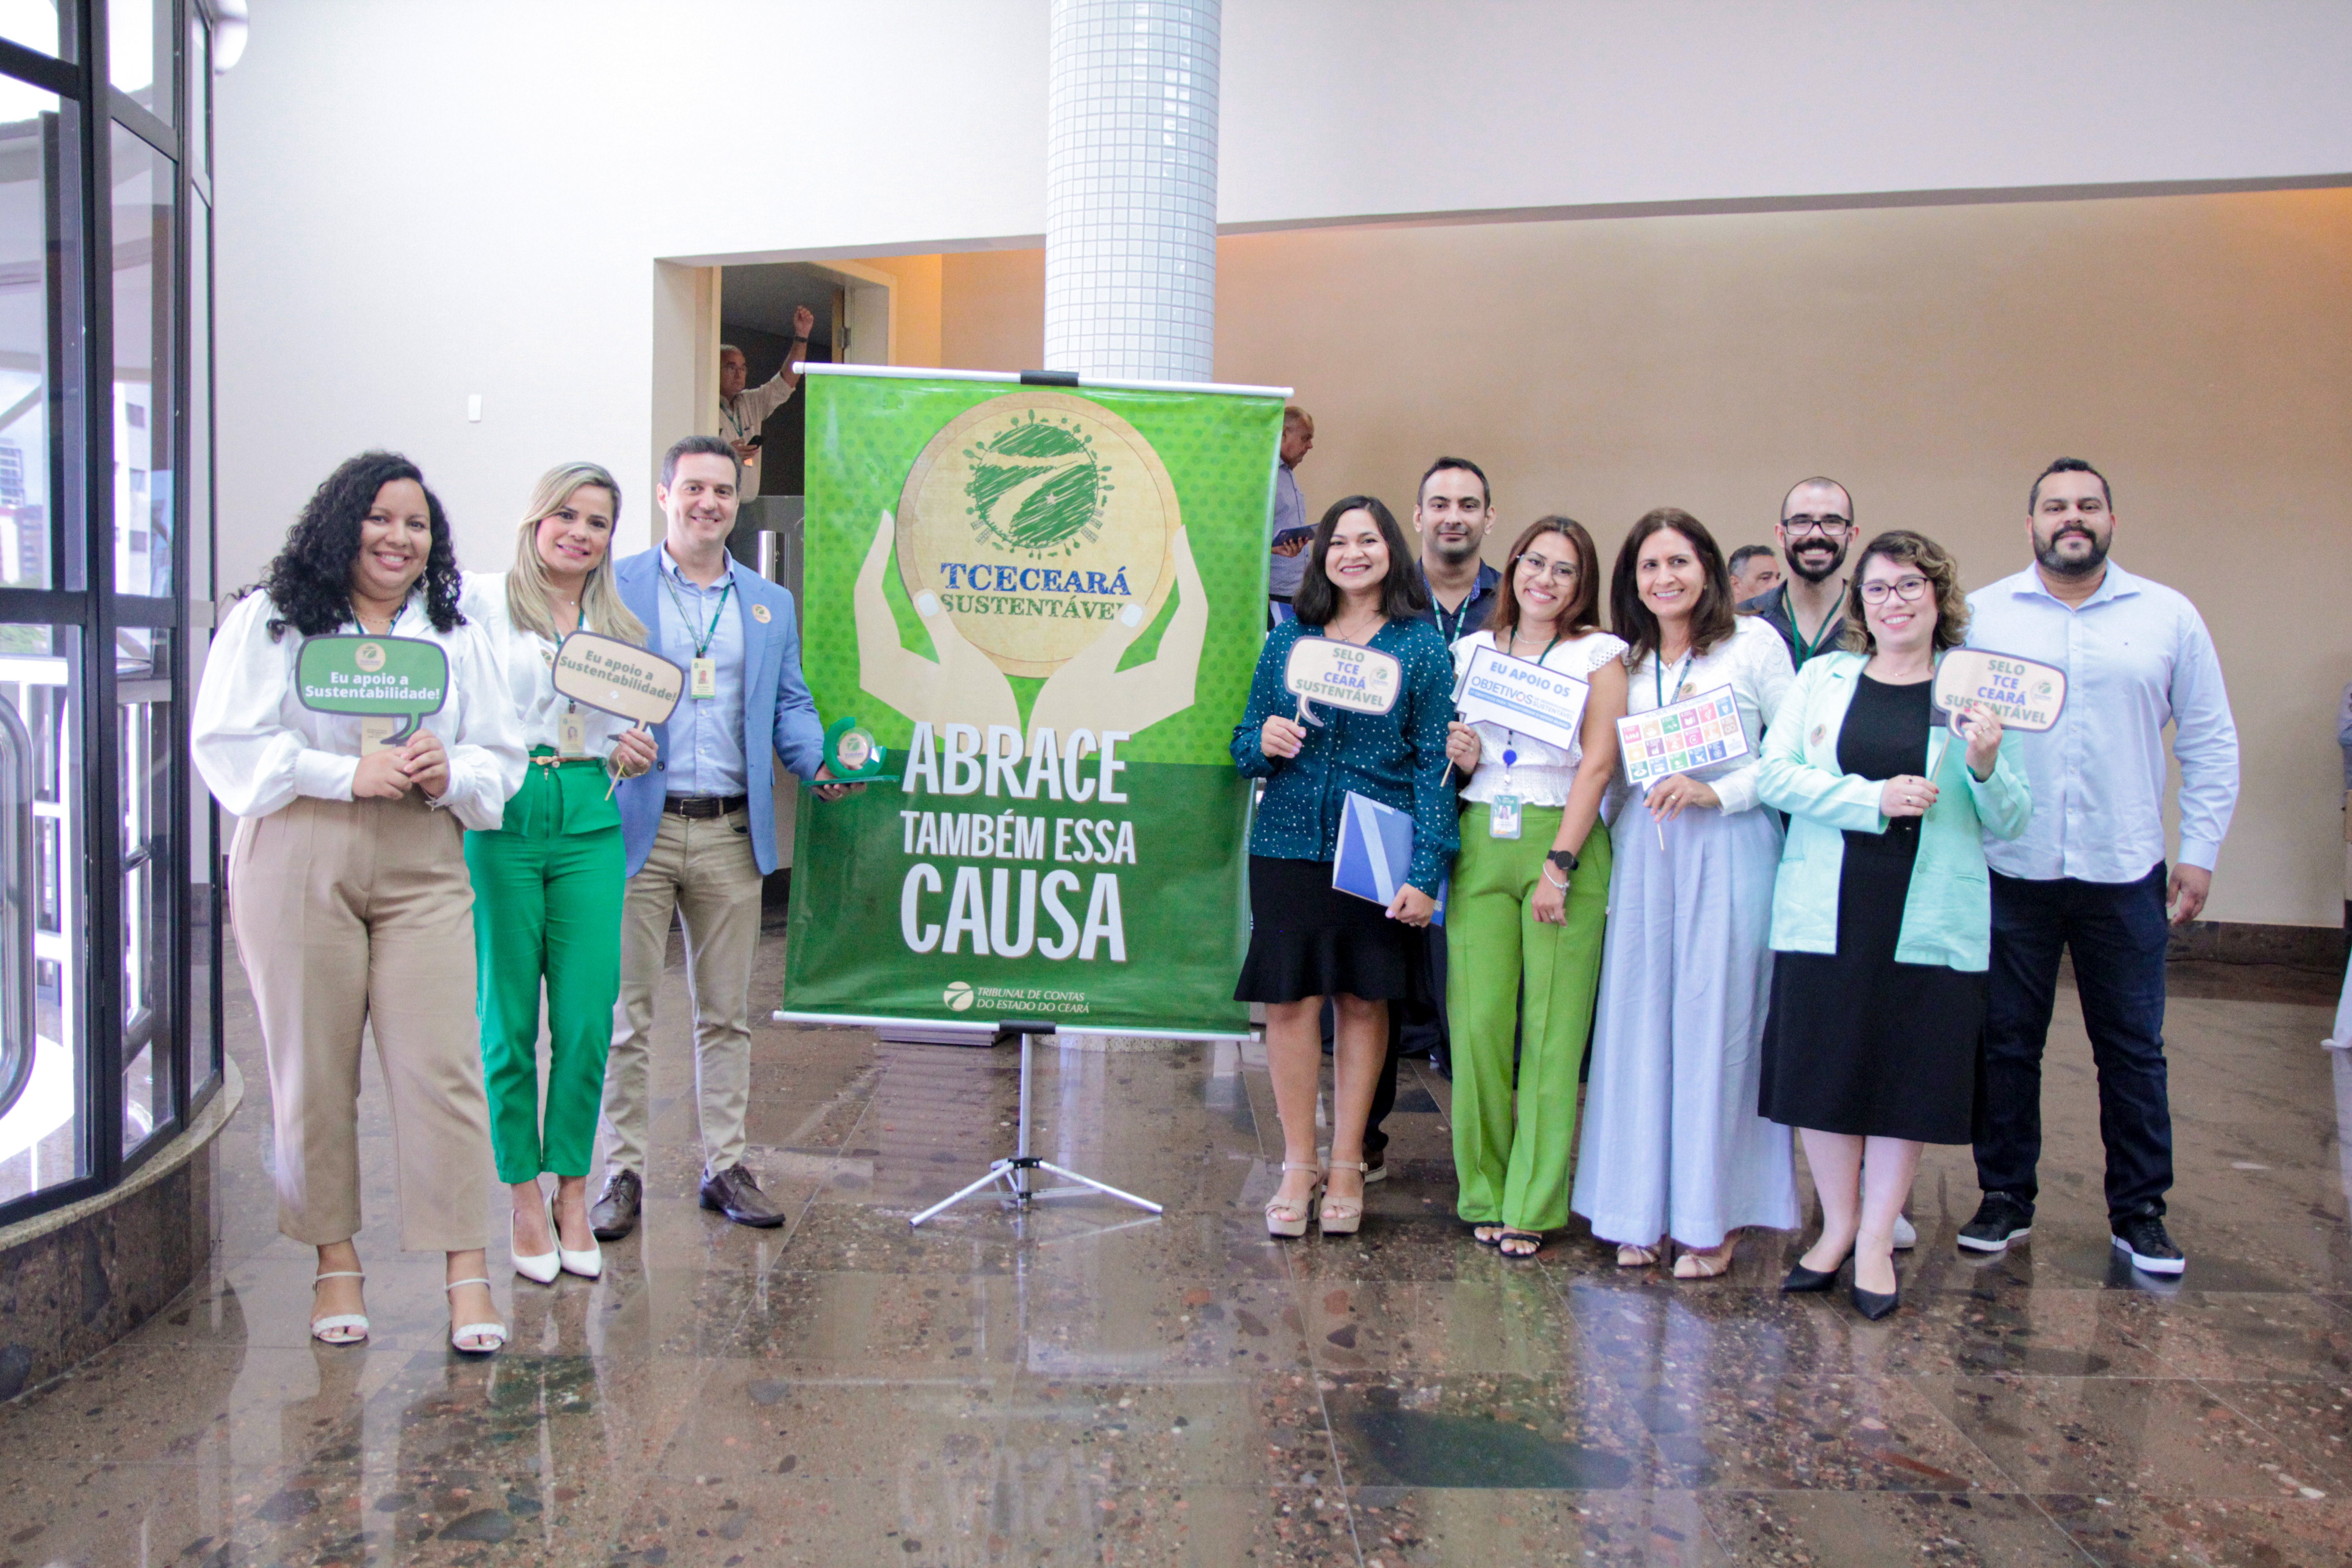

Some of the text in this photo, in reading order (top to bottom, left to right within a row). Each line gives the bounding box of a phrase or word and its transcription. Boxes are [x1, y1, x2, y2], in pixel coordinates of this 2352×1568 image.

[941, 593, 1124, 621] SUSTENTÁVE
[585, 650, 653, 681] Eu apoio a
[1333, 647, 1365, 662] SELO
[330, 671, 408, 687] Eu apoio a
[559, 656, 678, 702] Sustentabilidade!
[1337, 661, 1360, 675] TCE
[1490, 661, 1571, 697] EU APOIO OS
[1988, 659, 2026, 676] SELO
[305, 685, 440, 700] Sustentabilidade!
[1295, 678, 1384, 707] SUSTENTÁVEL
[1323, 671, 1366, 690] CEARÁ
[1471, 676, 1534, 705] OBJETIVOS
[1993, 674, 2019, 689] TCE
[1977, 686, 2027, 706] CEARÁ
[1944, 694, 2047, 725] SUSNTÁVEL
[902, 721, 1131, 804] ABRACE
[900, 808, 1137, 864] TAMBÉM ESSA
[901, 862, 1127, 962] CAUSA
[976, 999, 1090, 1013] DO ESTADO DO CEARÁ
[978, 987, 1085, 1001] TRIBUNAL DE CONTAS
